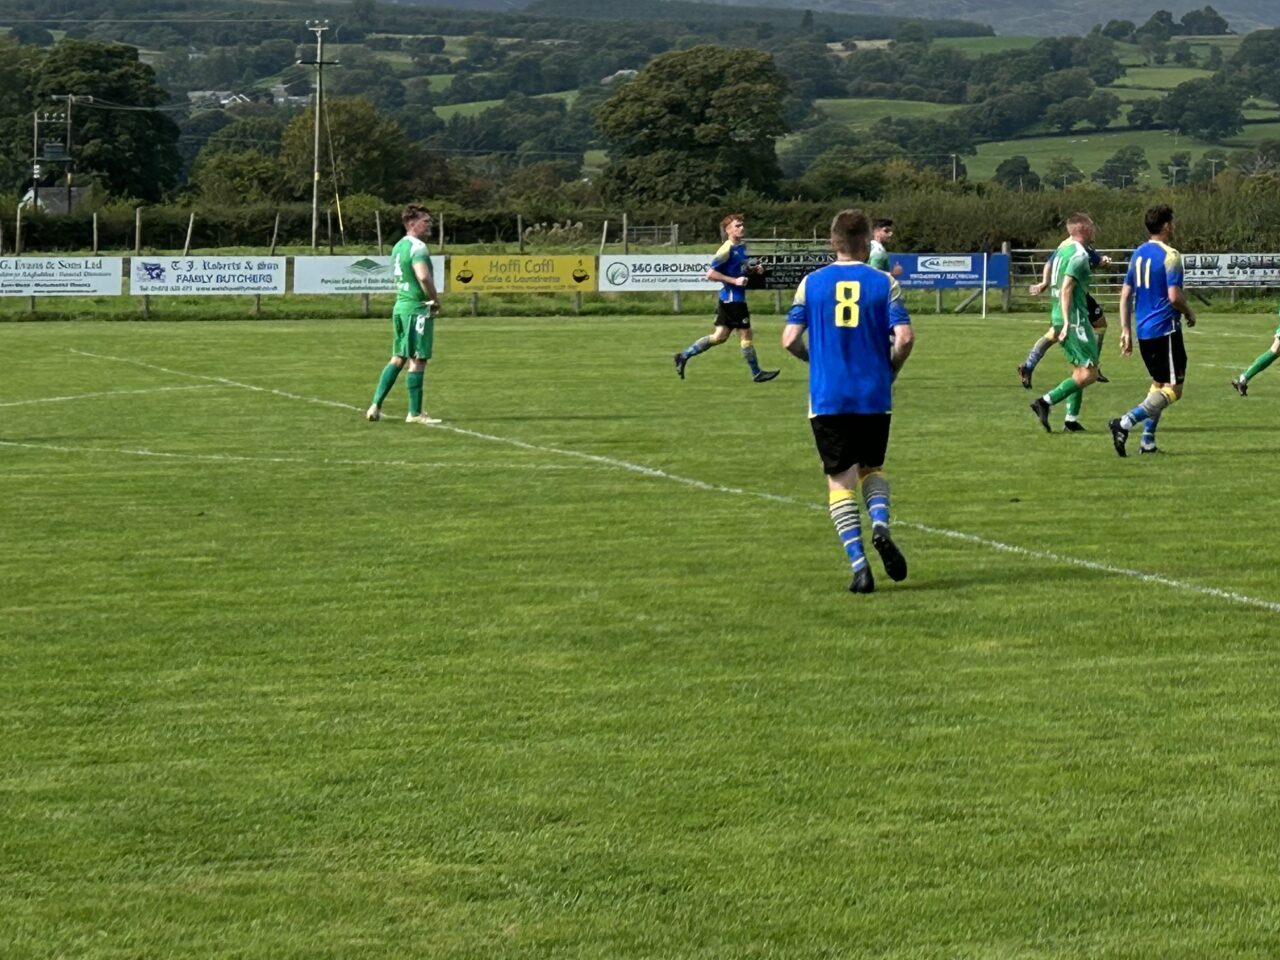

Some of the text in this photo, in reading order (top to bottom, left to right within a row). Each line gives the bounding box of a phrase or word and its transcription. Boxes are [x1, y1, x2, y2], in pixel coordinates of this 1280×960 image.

[15, 260, 43, 270] Evans
[46, 260, 55, 270] &
[58, 260, 82, 270] Sons
[85, 259, 103, 270] Ltd
[244, 260, 254, 271] &
[489, 259, 555, 273] Hoffi Coffi
[631, 263, 652, 273] 360
[1135, 256, 1152, 289] 11
[176, 274, 273, 284] FAMILY BUTCHERS
[835, 281, 860, 327] 8
